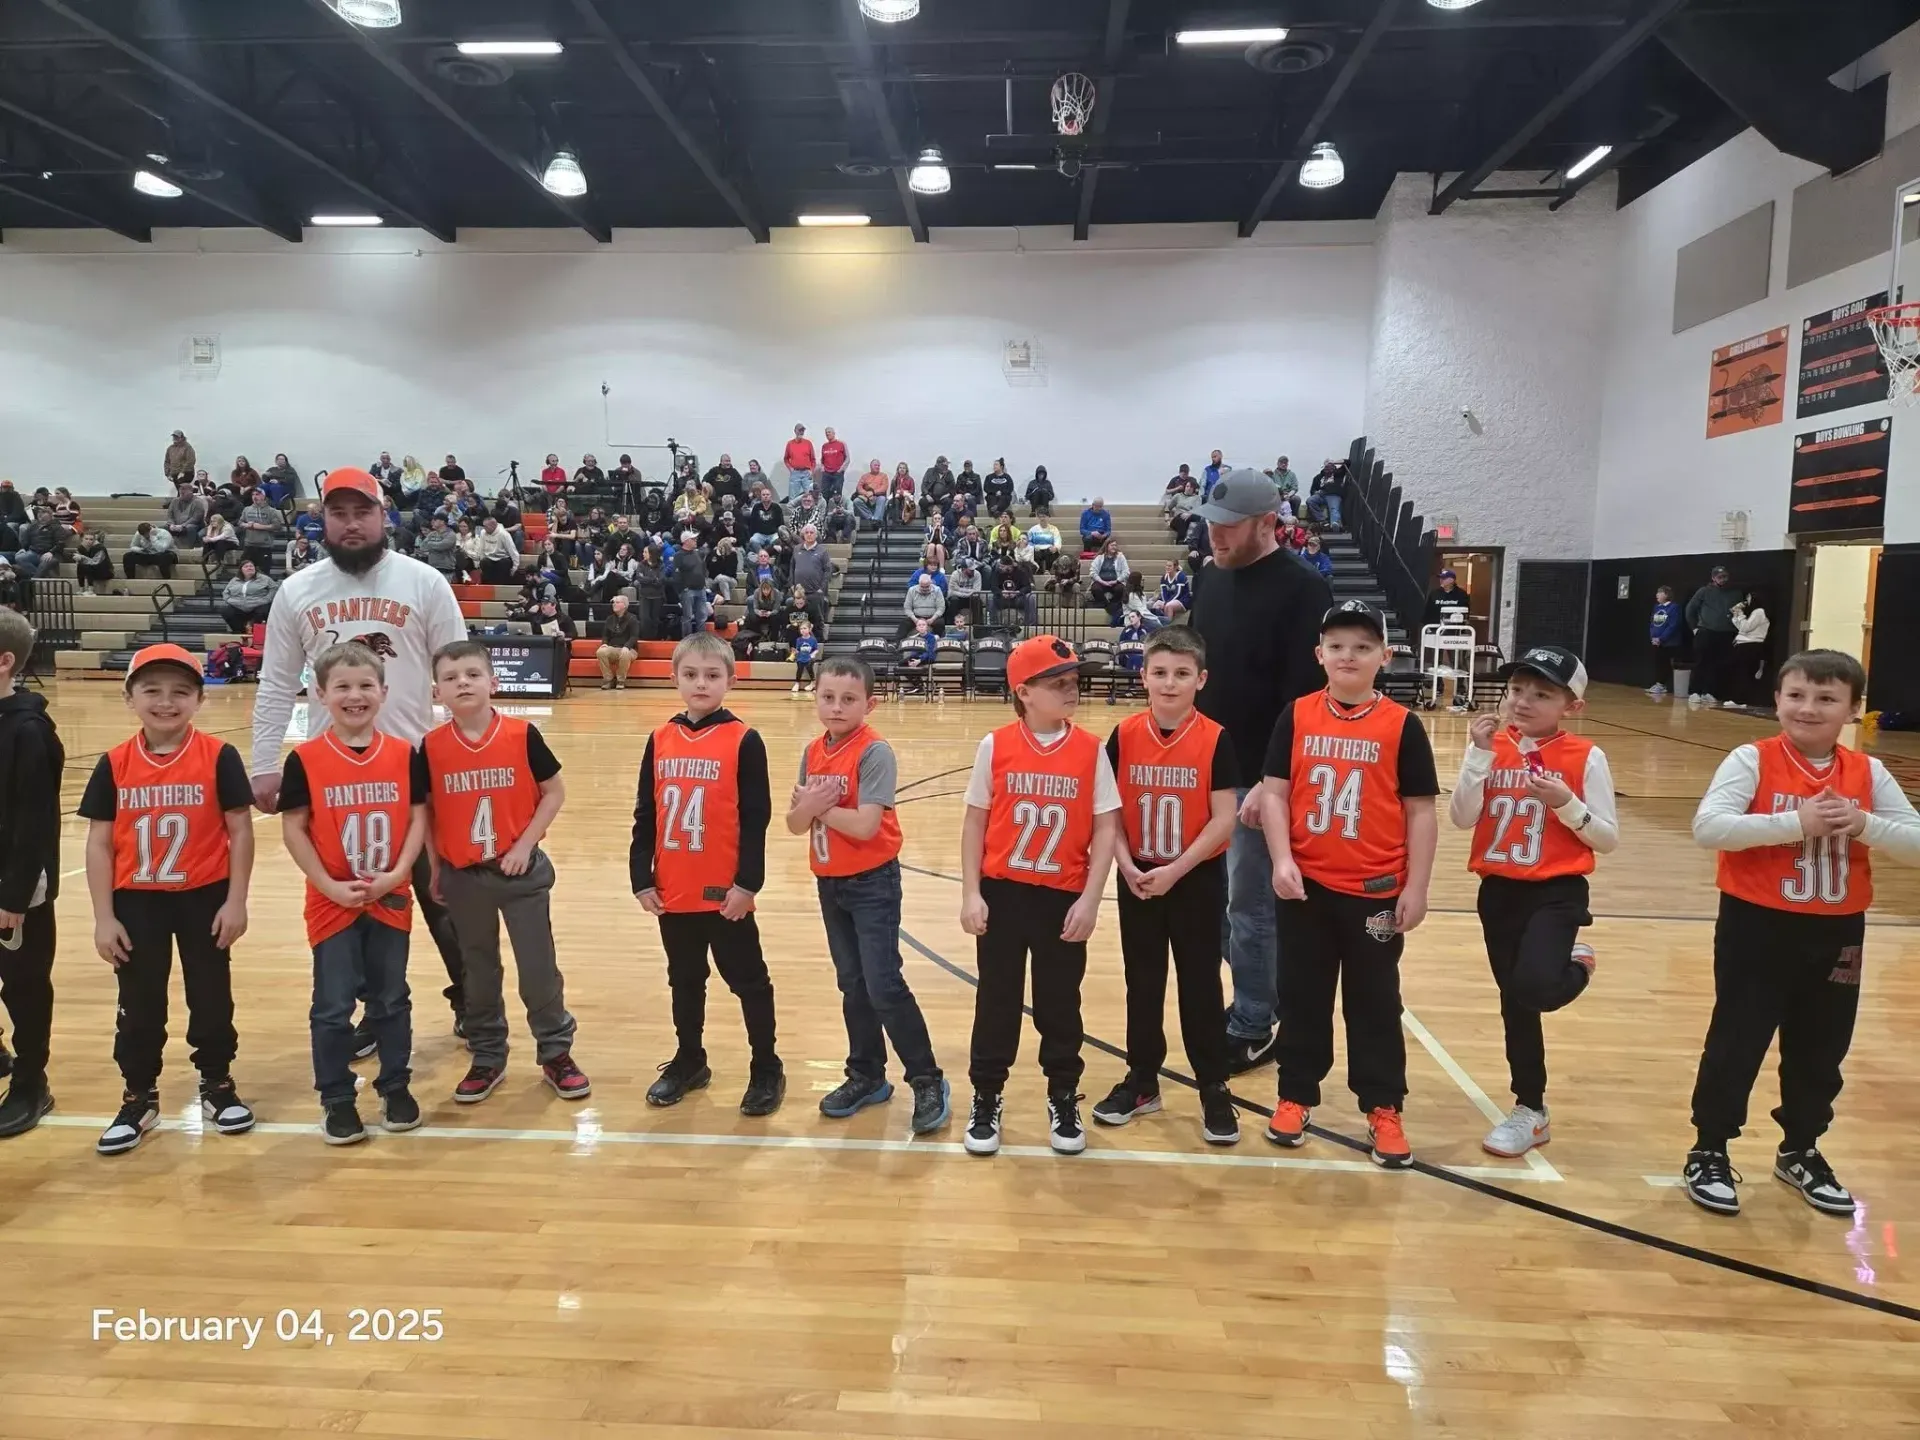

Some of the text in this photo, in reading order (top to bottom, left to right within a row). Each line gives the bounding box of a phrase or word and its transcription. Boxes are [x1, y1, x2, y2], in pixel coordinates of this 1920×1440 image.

[1832, 299, 1868, 321] BOYS GOLF
[1816, 429, 1833, 443] BOYS
[1833, 423, 1865, 441] BOWLING
[327, 597, 410, 628] PANTHERS
[1303, 735, 1380, 764] PANTHERS
[444, 767, 515, 794] PANTHERS
[658, 757, 721, 780] PANTHERS
[1129, 764, 1198, 789] PANTHERS
[119, 784, 205, 810] PANTHERS
[324, 782, 400, 807] PANTHERS
[1006, 771, 1079, 799] PANTHERS
[1306, 763, 1364, 840] 34
[470, 795, 498, 864] 4
[662, 784, 706, 852] 24
[1137, 792, 1183, 860] 10
[1483, 794, 1547, 867] 23
[132, 812, 189, 883] 12
[341, 810, 392, 879] 48
[1007, 800, 1067, 875] 22
[1780, 835, 1850, 904] 30
